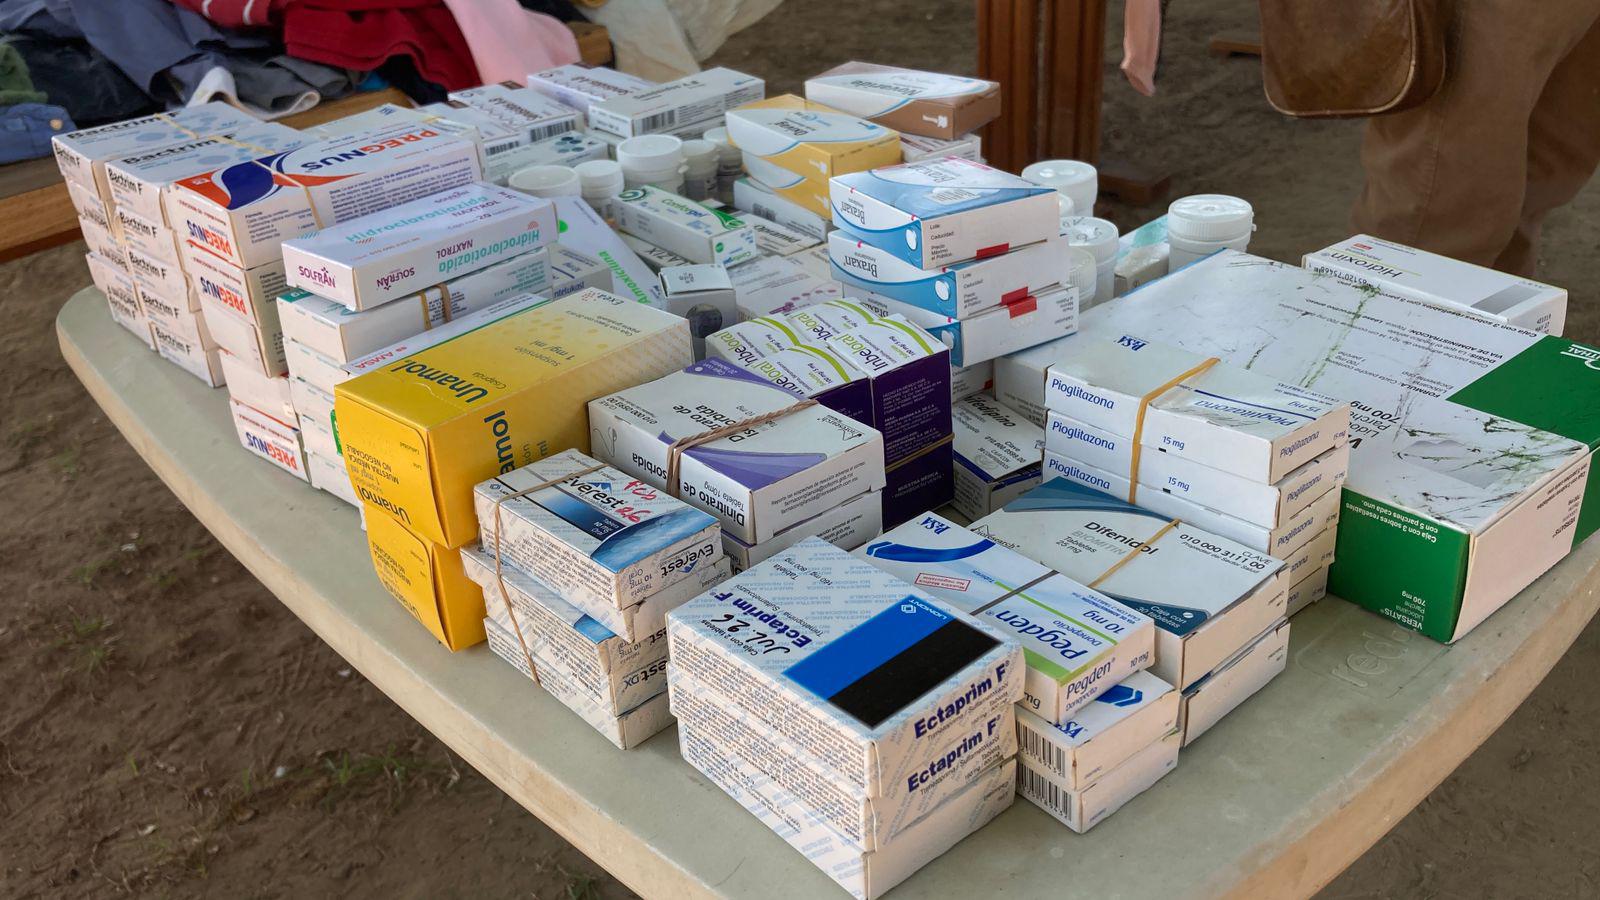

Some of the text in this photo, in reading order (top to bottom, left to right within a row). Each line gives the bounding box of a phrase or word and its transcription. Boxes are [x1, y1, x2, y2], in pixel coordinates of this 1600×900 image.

[66, 113, 162, 140] Bactrim
[122, 138, 221, 165] Bactrim
[301, 130, 440, 172] PREGNUS
[108, 168, 138, 193] Bactrim
[345, 195, 488, 241] Hidroclorotiazida
[452, 199, 499, 217] NAXTROL
[841, 201, 865, 225] Braxan
[119, 212, 152, 236] Bactrim
[186, 219, 233, 257] PREGNUS
[436, 239, 473, 260] NAXTROL
[438, 229, 540, 273] Hidroclorotiazida
[128, 250, 162, 277] Bactrim
[845, 255, 878, 278] Braxan
[1331, 251, 1403, 278] Hidroxin
[141, 291, 174, 317] Bactrim
[200, 276, 247, 316] PREGNUS
[155, 327, 187, 353] Bactrim
[1518, 329, 1537, 337] Caja
[352, 350, 394, 370] AMSA
[837, 332, 888, 372] Inbeloral
[391, 358, 488, 403] Unamol
[1051, 379, 1115, 409] Pioglitazona
[1288, 401, 1322, 413] 15 mg
[672, 405, 691, 417] de
[1195, 400, 1298, 427] Pioglitazona
[1350, 401, 1401, 423] 700 mg
[1052, 421, 1116, 451] Pioglitazona
[1163, 436, 1185, 450] 15 mg
[1280, 430, 1320, 458] Pioglitazona
[246, 431, 298, 470] PREGNUS
[346, 445, 392, 471] NO NEGOCIABLE
[371, 466, 399, 484] MUESTRA
[1048, 459, 1110, 490] Pioglitazona
[1167, 477, 1190, 491] 15 mg
[682, 482, 697, 498] de
[1286, 474, 1322, 502] Pioglitazona
[357, 485, 411, 525] Unamol
[698, 491, 745, 527] Dinitrato
[722, 492, 745, 511] Tableta
[1345, 502, 1437, 543] Caja con sobres resellables
[1361, 500, 1439, 534] con parches cada uno.
[1063, 536, 1097, 553] Tabletas
[1084, 521, 1159, 555] Difenidol
[1277, 516, 1314, 547] Pioglitazona
[661, 544, 714, 577] Everest
[1065, 544, 1082, 554] mg
[1180, 534, 1265, 570] 010 000 3111 00
[1242, 551, 1273, 566] CLAVE
[629, 568, 643, 581] Oral
[630, 578, 643, 587] mg
[773, 563, 800, 581] Tableta
[1401, 590, 1426, 607] 700 mg
[1404, 600, 1425, 614] Parche
[711, 614, 751, 632] 26
[713, 591, 812, 649] Ectaprim F
[1083, 611, 1126, 634] 10 mg
[1151, 605, 1187, 624] Caja con
[1385, 607, 1423, 630] VERSATIS
[996, 610, 1088, 660] Pegden
[1130, 652, 1150, 668] 10 mg
[1066, 661, 1111, 700] Pegden
[913, 664, 1006, 739] Ectaprim F
[908, 718, 998, 792] Ectaprim F
